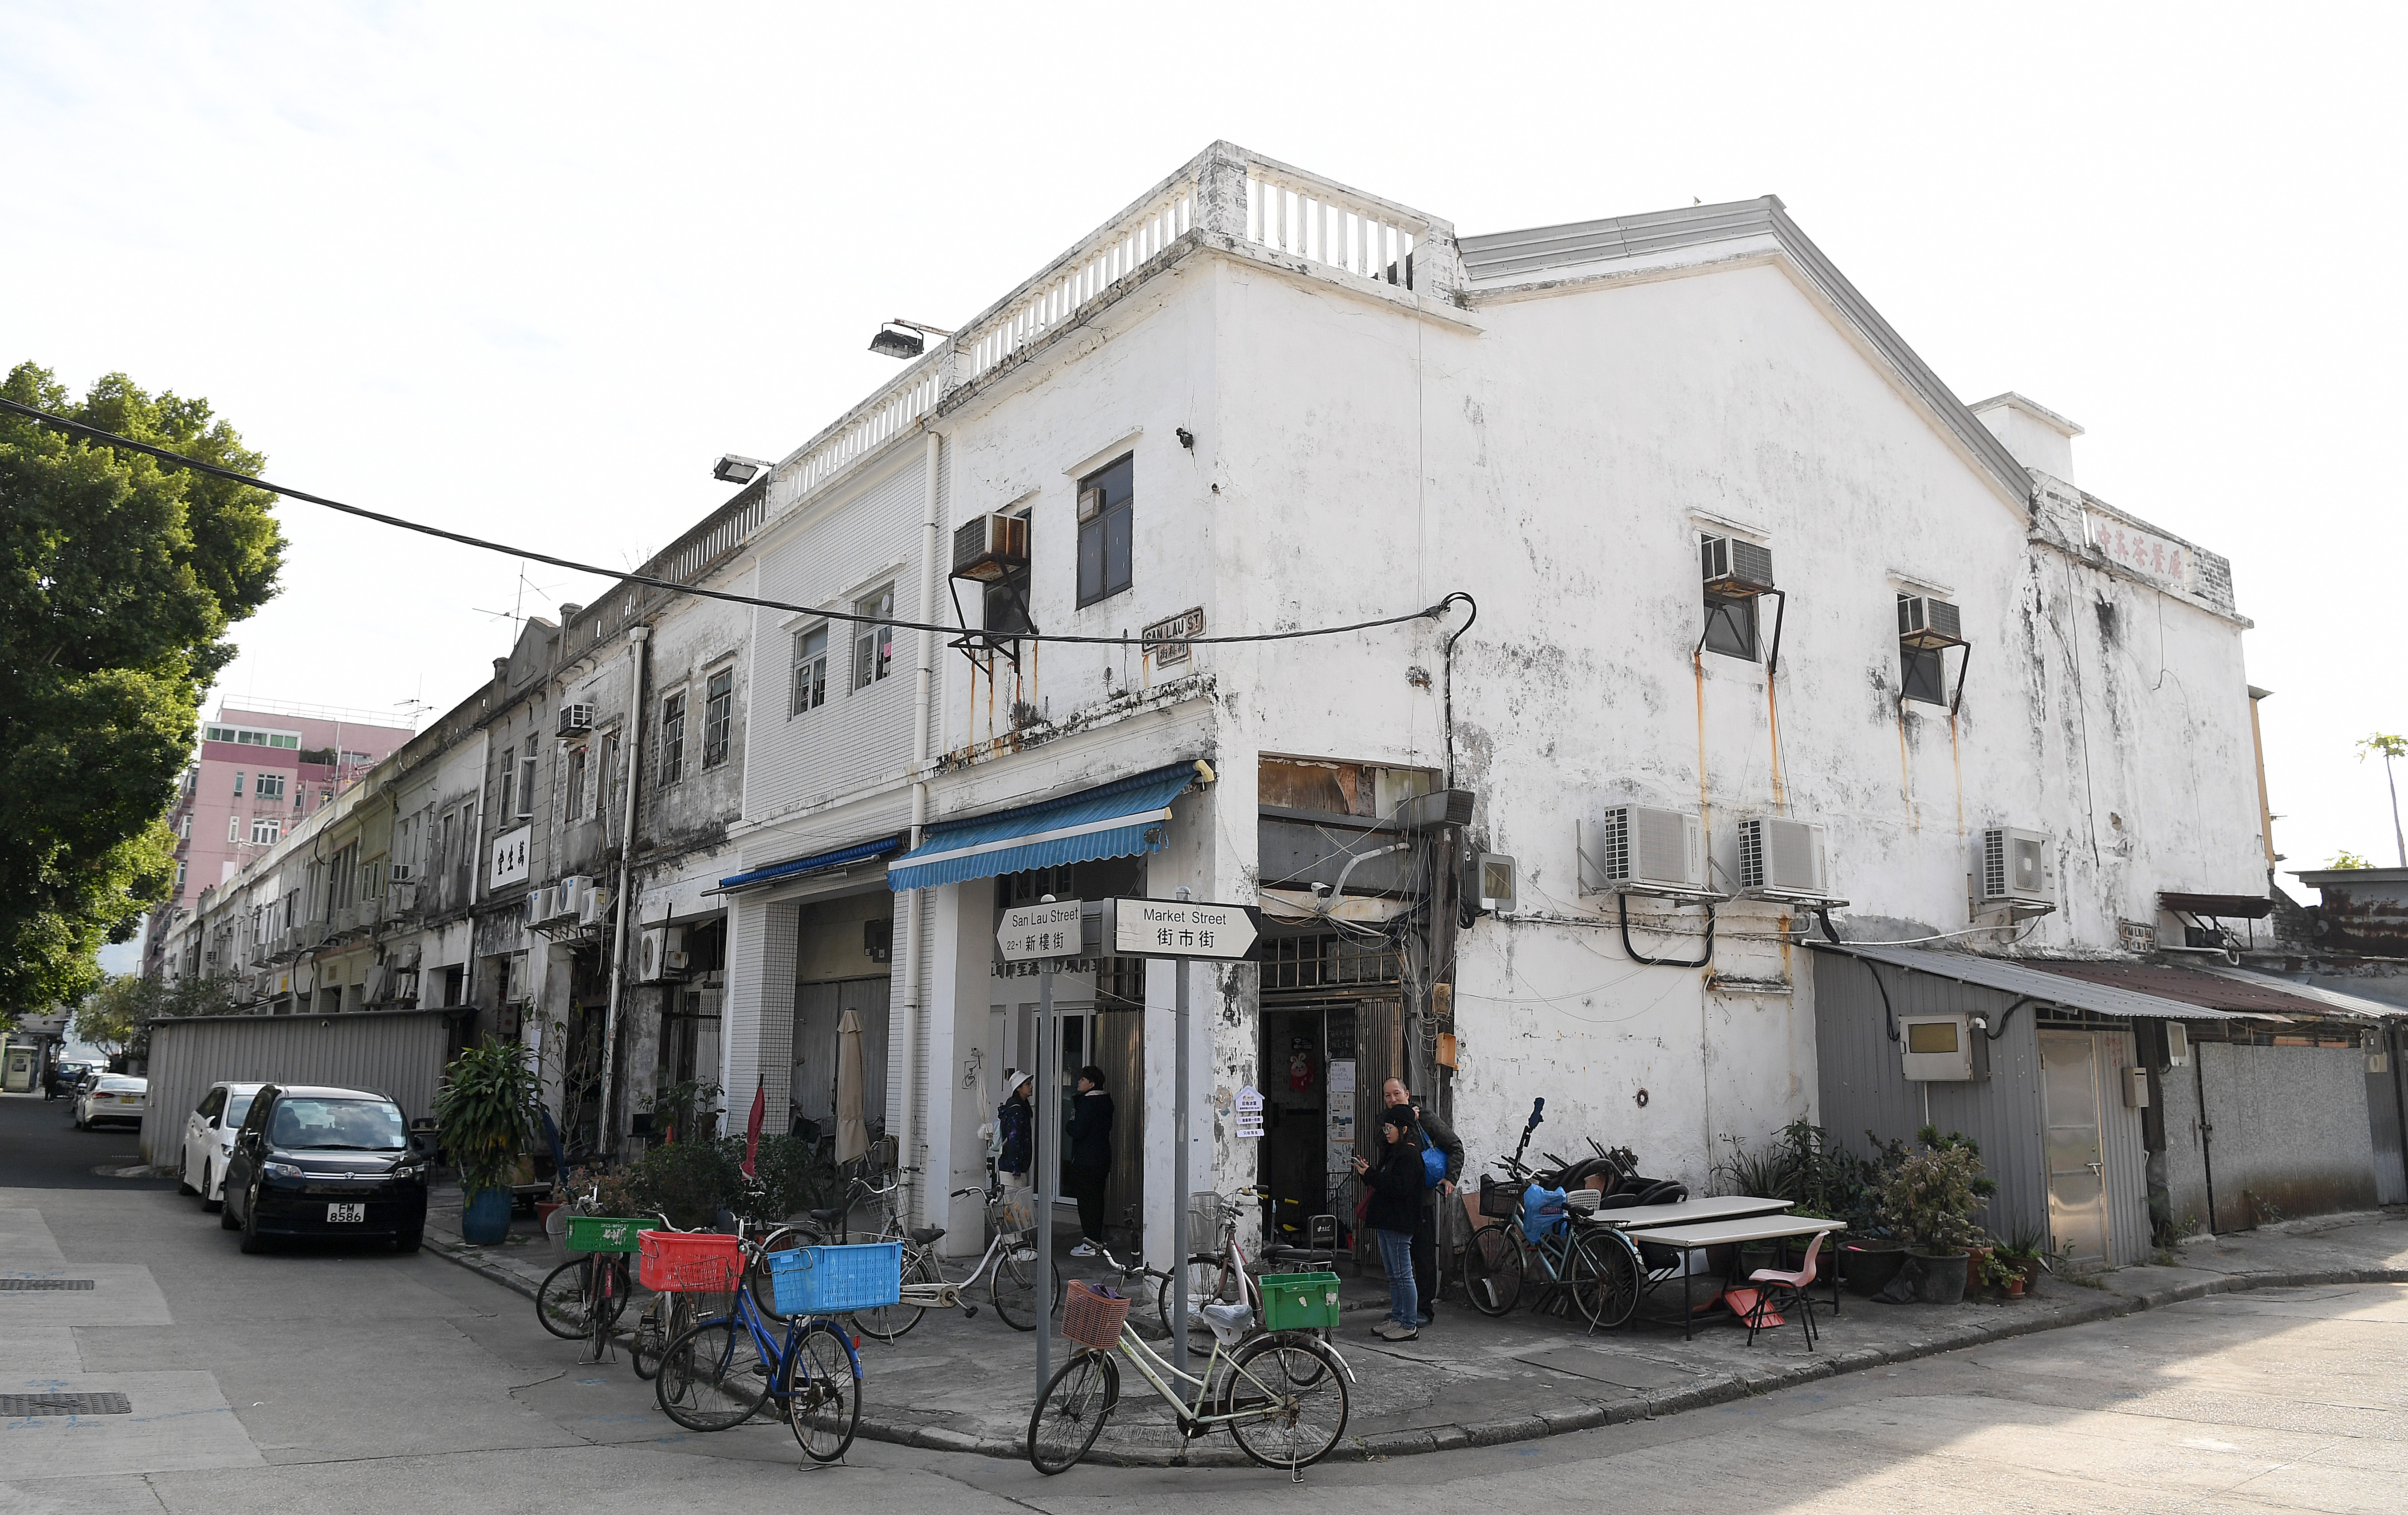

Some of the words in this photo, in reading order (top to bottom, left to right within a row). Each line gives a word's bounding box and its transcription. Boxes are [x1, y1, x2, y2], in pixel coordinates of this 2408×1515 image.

[1146, 627, 1163, 647] SAN
[1166, 619, 1184, 638] LAU
[1012, 914, 1029, 928] San
[1031, 911, 1048, 926] Lau
[1050, 907, 1078, 922] Street
[1144, 908, 1185, 923] Market
[1192, 911, 1227, 926] Street
[1025, 931, 1064, 952] 新樓街
[1156, 927, 1216, 949] 街市街
[330, 1213, 361, 1221] 8586
[339, 1203, 354, 1212] FM
